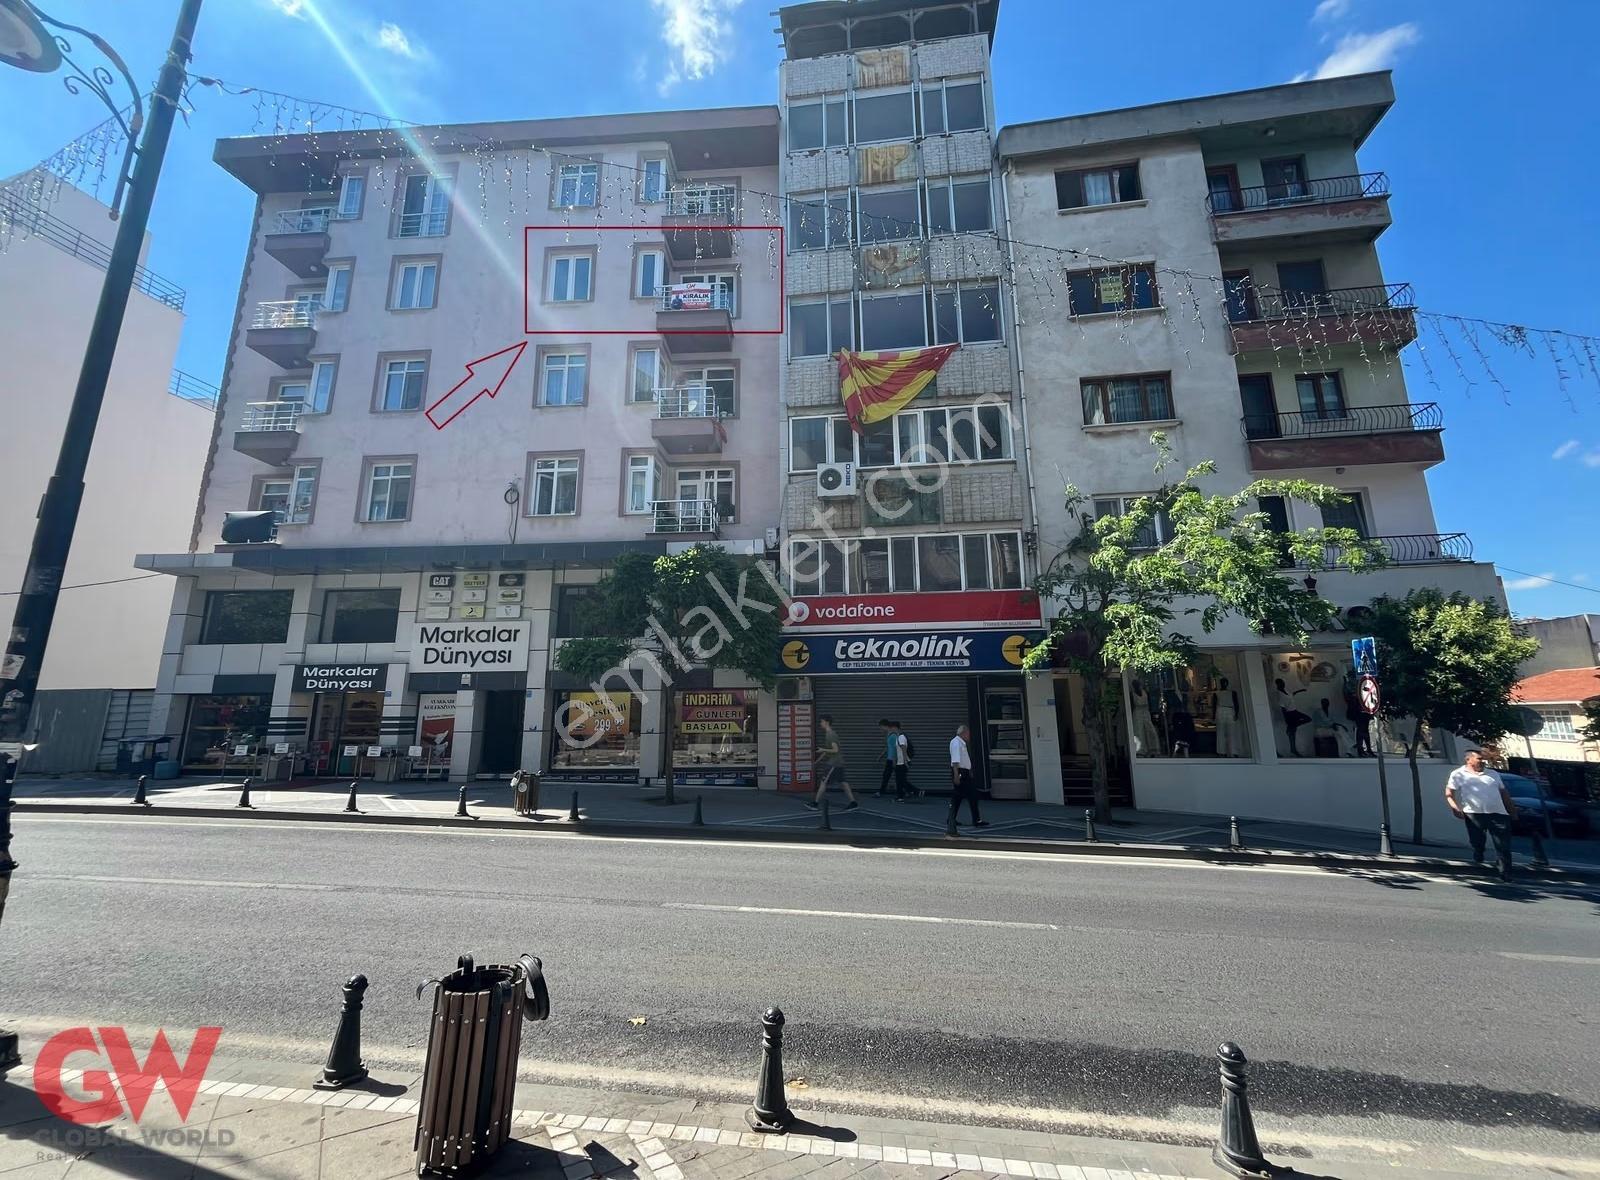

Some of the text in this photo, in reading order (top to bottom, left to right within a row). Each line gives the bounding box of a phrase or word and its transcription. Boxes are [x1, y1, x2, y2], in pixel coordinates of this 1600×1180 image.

[432, 576, 450, 586] CAT
[815, 603, 895, 618] vodafone
[419, 625, 521, 644] Markalar
[835, 636, 973, 659] teknolink
[423, 645, 512, 667] Dünyası
[302, 665, 379, 678] Markalar
[305, 677, 373, 691] Dünyası
[685, 722, 731, 733] BAŞLADI
